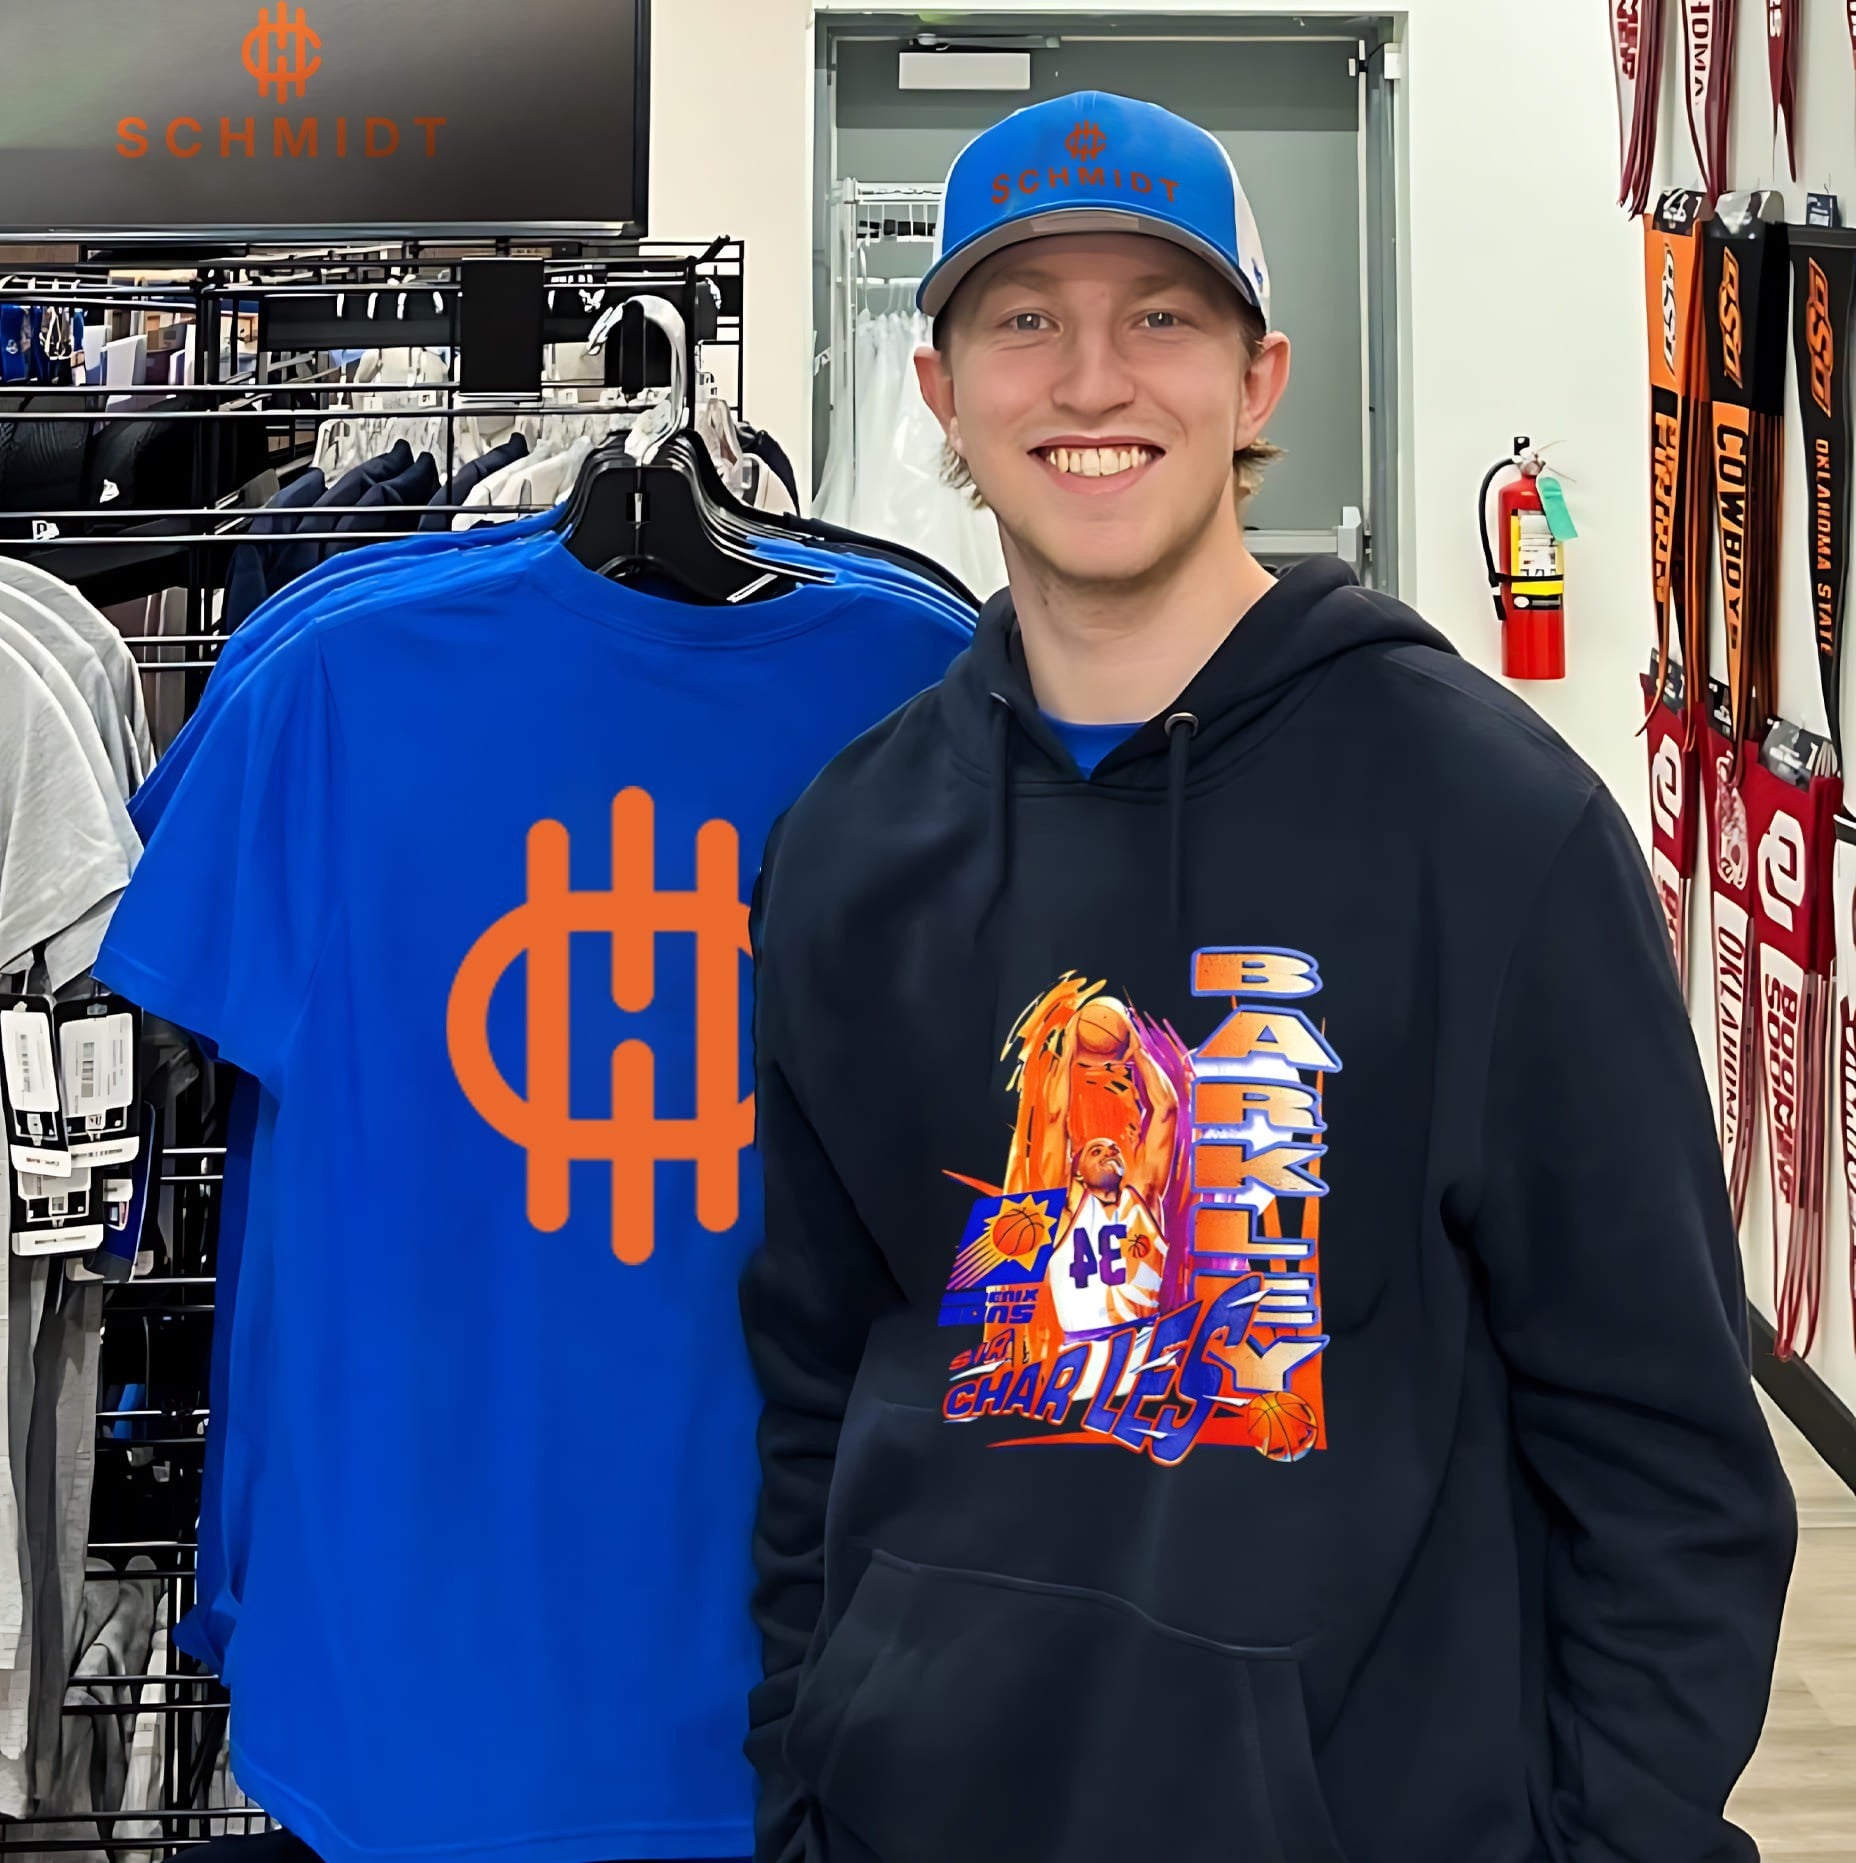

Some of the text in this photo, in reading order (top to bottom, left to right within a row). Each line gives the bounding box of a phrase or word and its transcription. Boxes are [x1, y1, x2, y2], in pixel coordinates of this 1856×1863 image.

[115, 116, 448, 159] SCHMIDT
[991, 167, 1180, 205] SCHMIDT
[1190, 945, 1343, 1393] BARKLEY
[942, 1272, 1266, 1467] CHARLES
